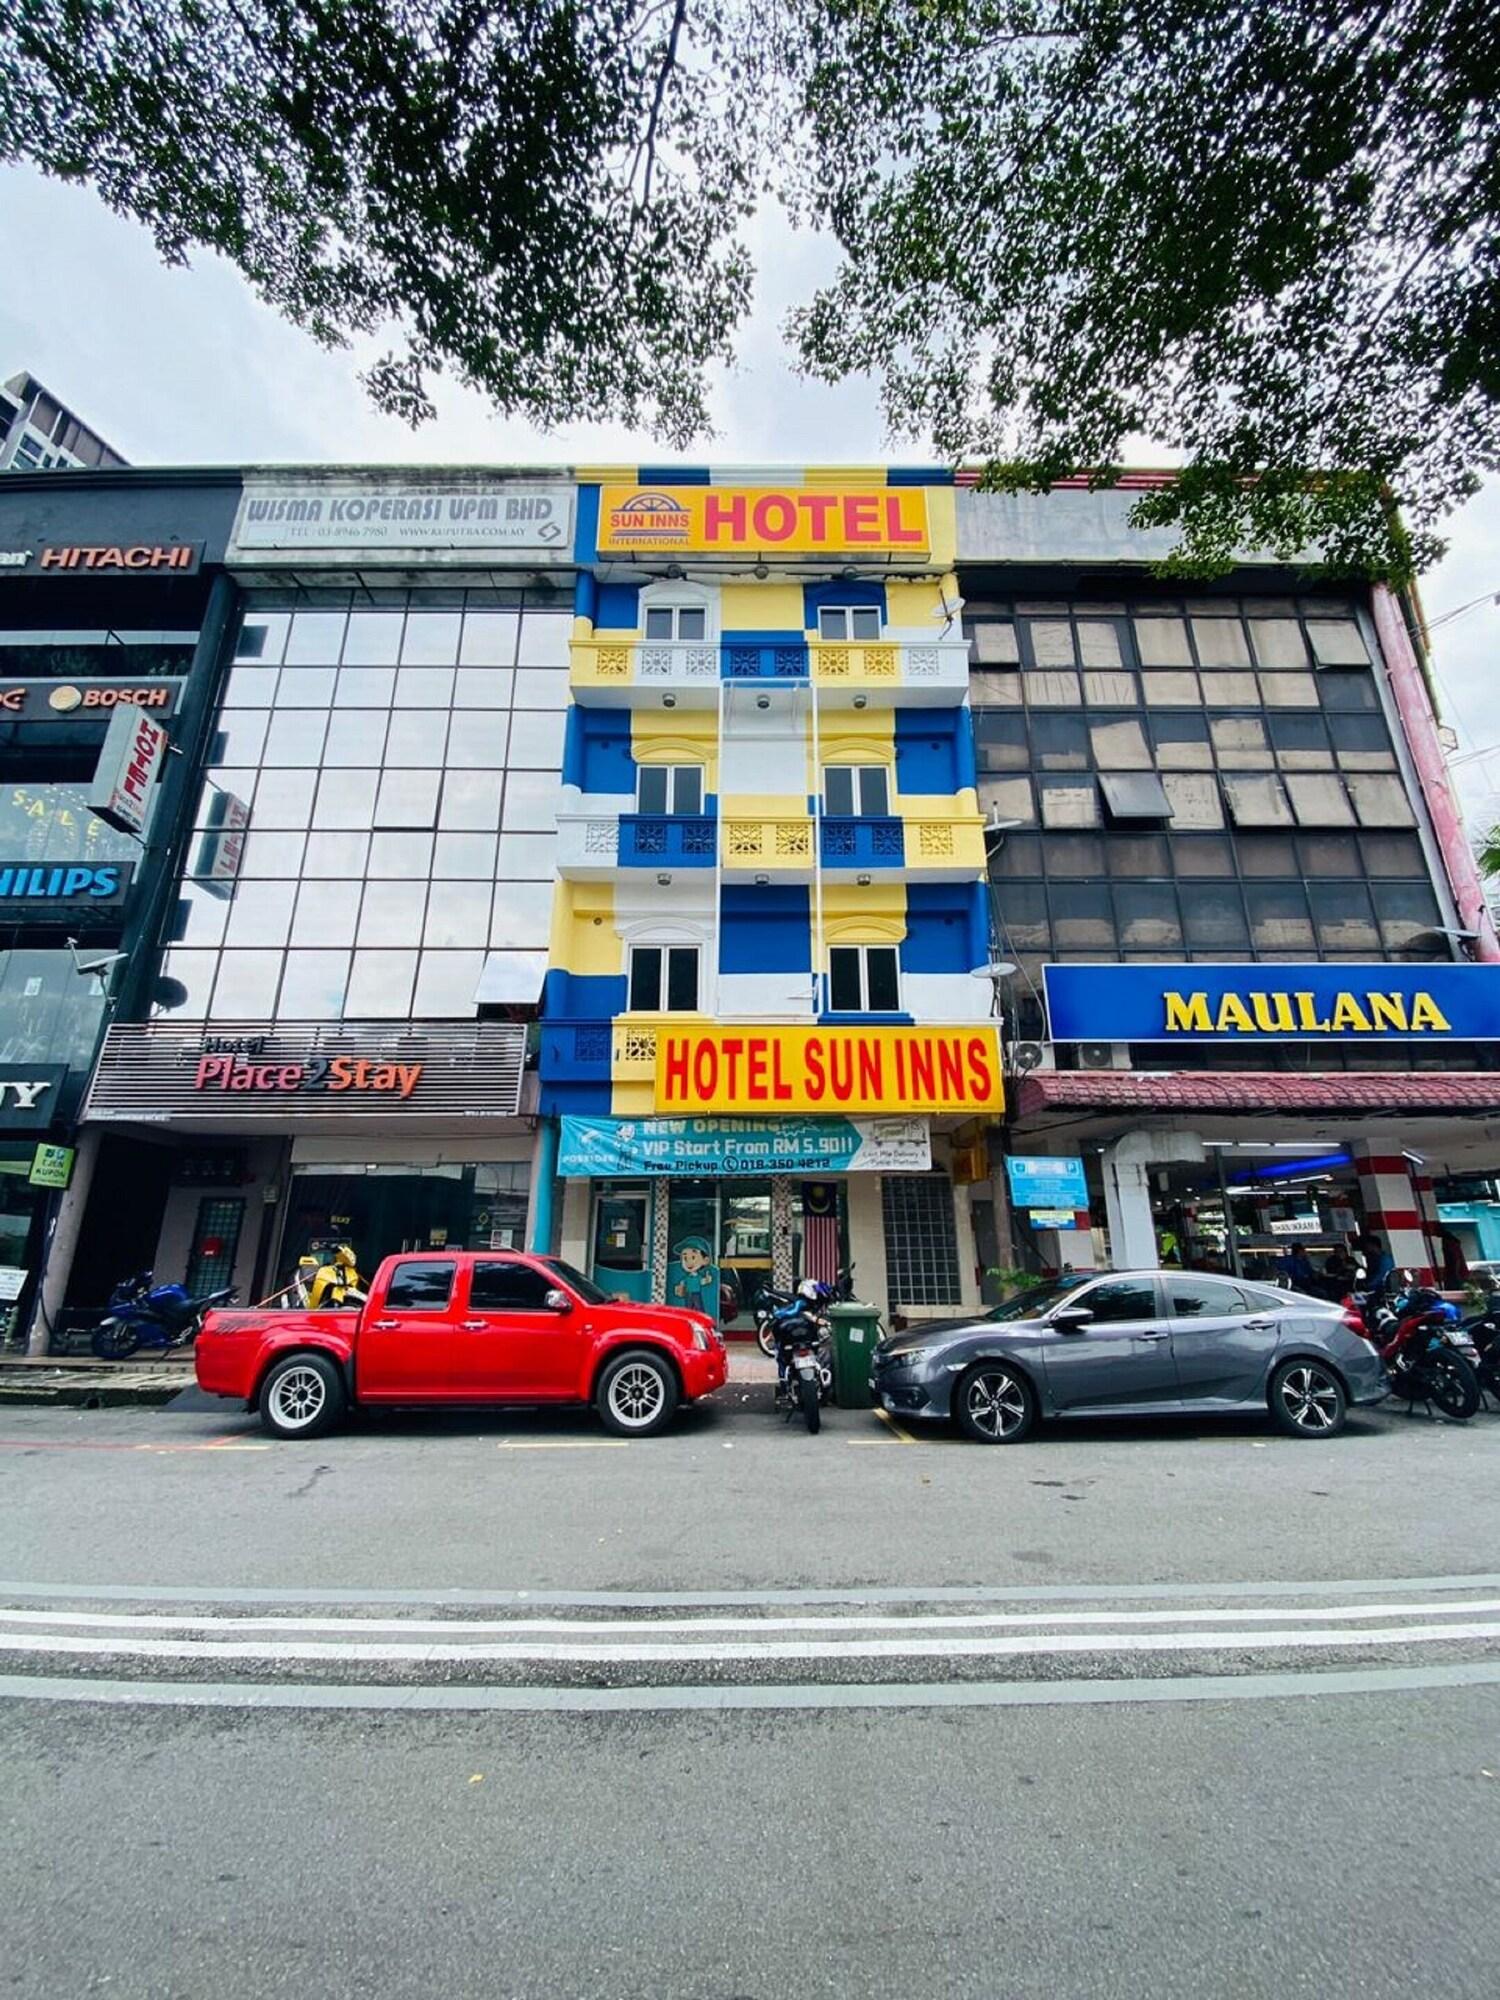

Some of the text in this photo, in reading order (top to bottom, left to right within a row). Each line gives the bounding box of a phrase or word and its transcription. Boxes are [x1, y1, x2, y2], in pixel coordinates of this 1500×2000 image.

[247, 498, 553, 521] WISMA KOPERASI UPM BHD
[705, 495, 923, 542] HOTEL
[610, 514, 689, 527] SUN INNS
[609, 537, 690, 545] INTERNATIONAL
[41, 547, 192, 568] HITACHI
[82, 689, 167, 706] BOSCH
[124, 719, 159, 802] HOTEL
[1163, 992, 1451, 1032] MAULANA
[203, 1036, 264, 1053] Hotel
[195, 1055, 423, 1099] Place2Stay
[665, 1038, 992, 1102] HOTEL SUN INNS
[643, 1118, 780, 1134] NEW OPENING
[643, 1140, 669, 1155] VIP
[674, 1140, 720, 1155] Start
[725, 1138, 769, 1154] From
[773, 1138, 799, 1154] RM
[676, 1160, 718, 1172] Pickup
